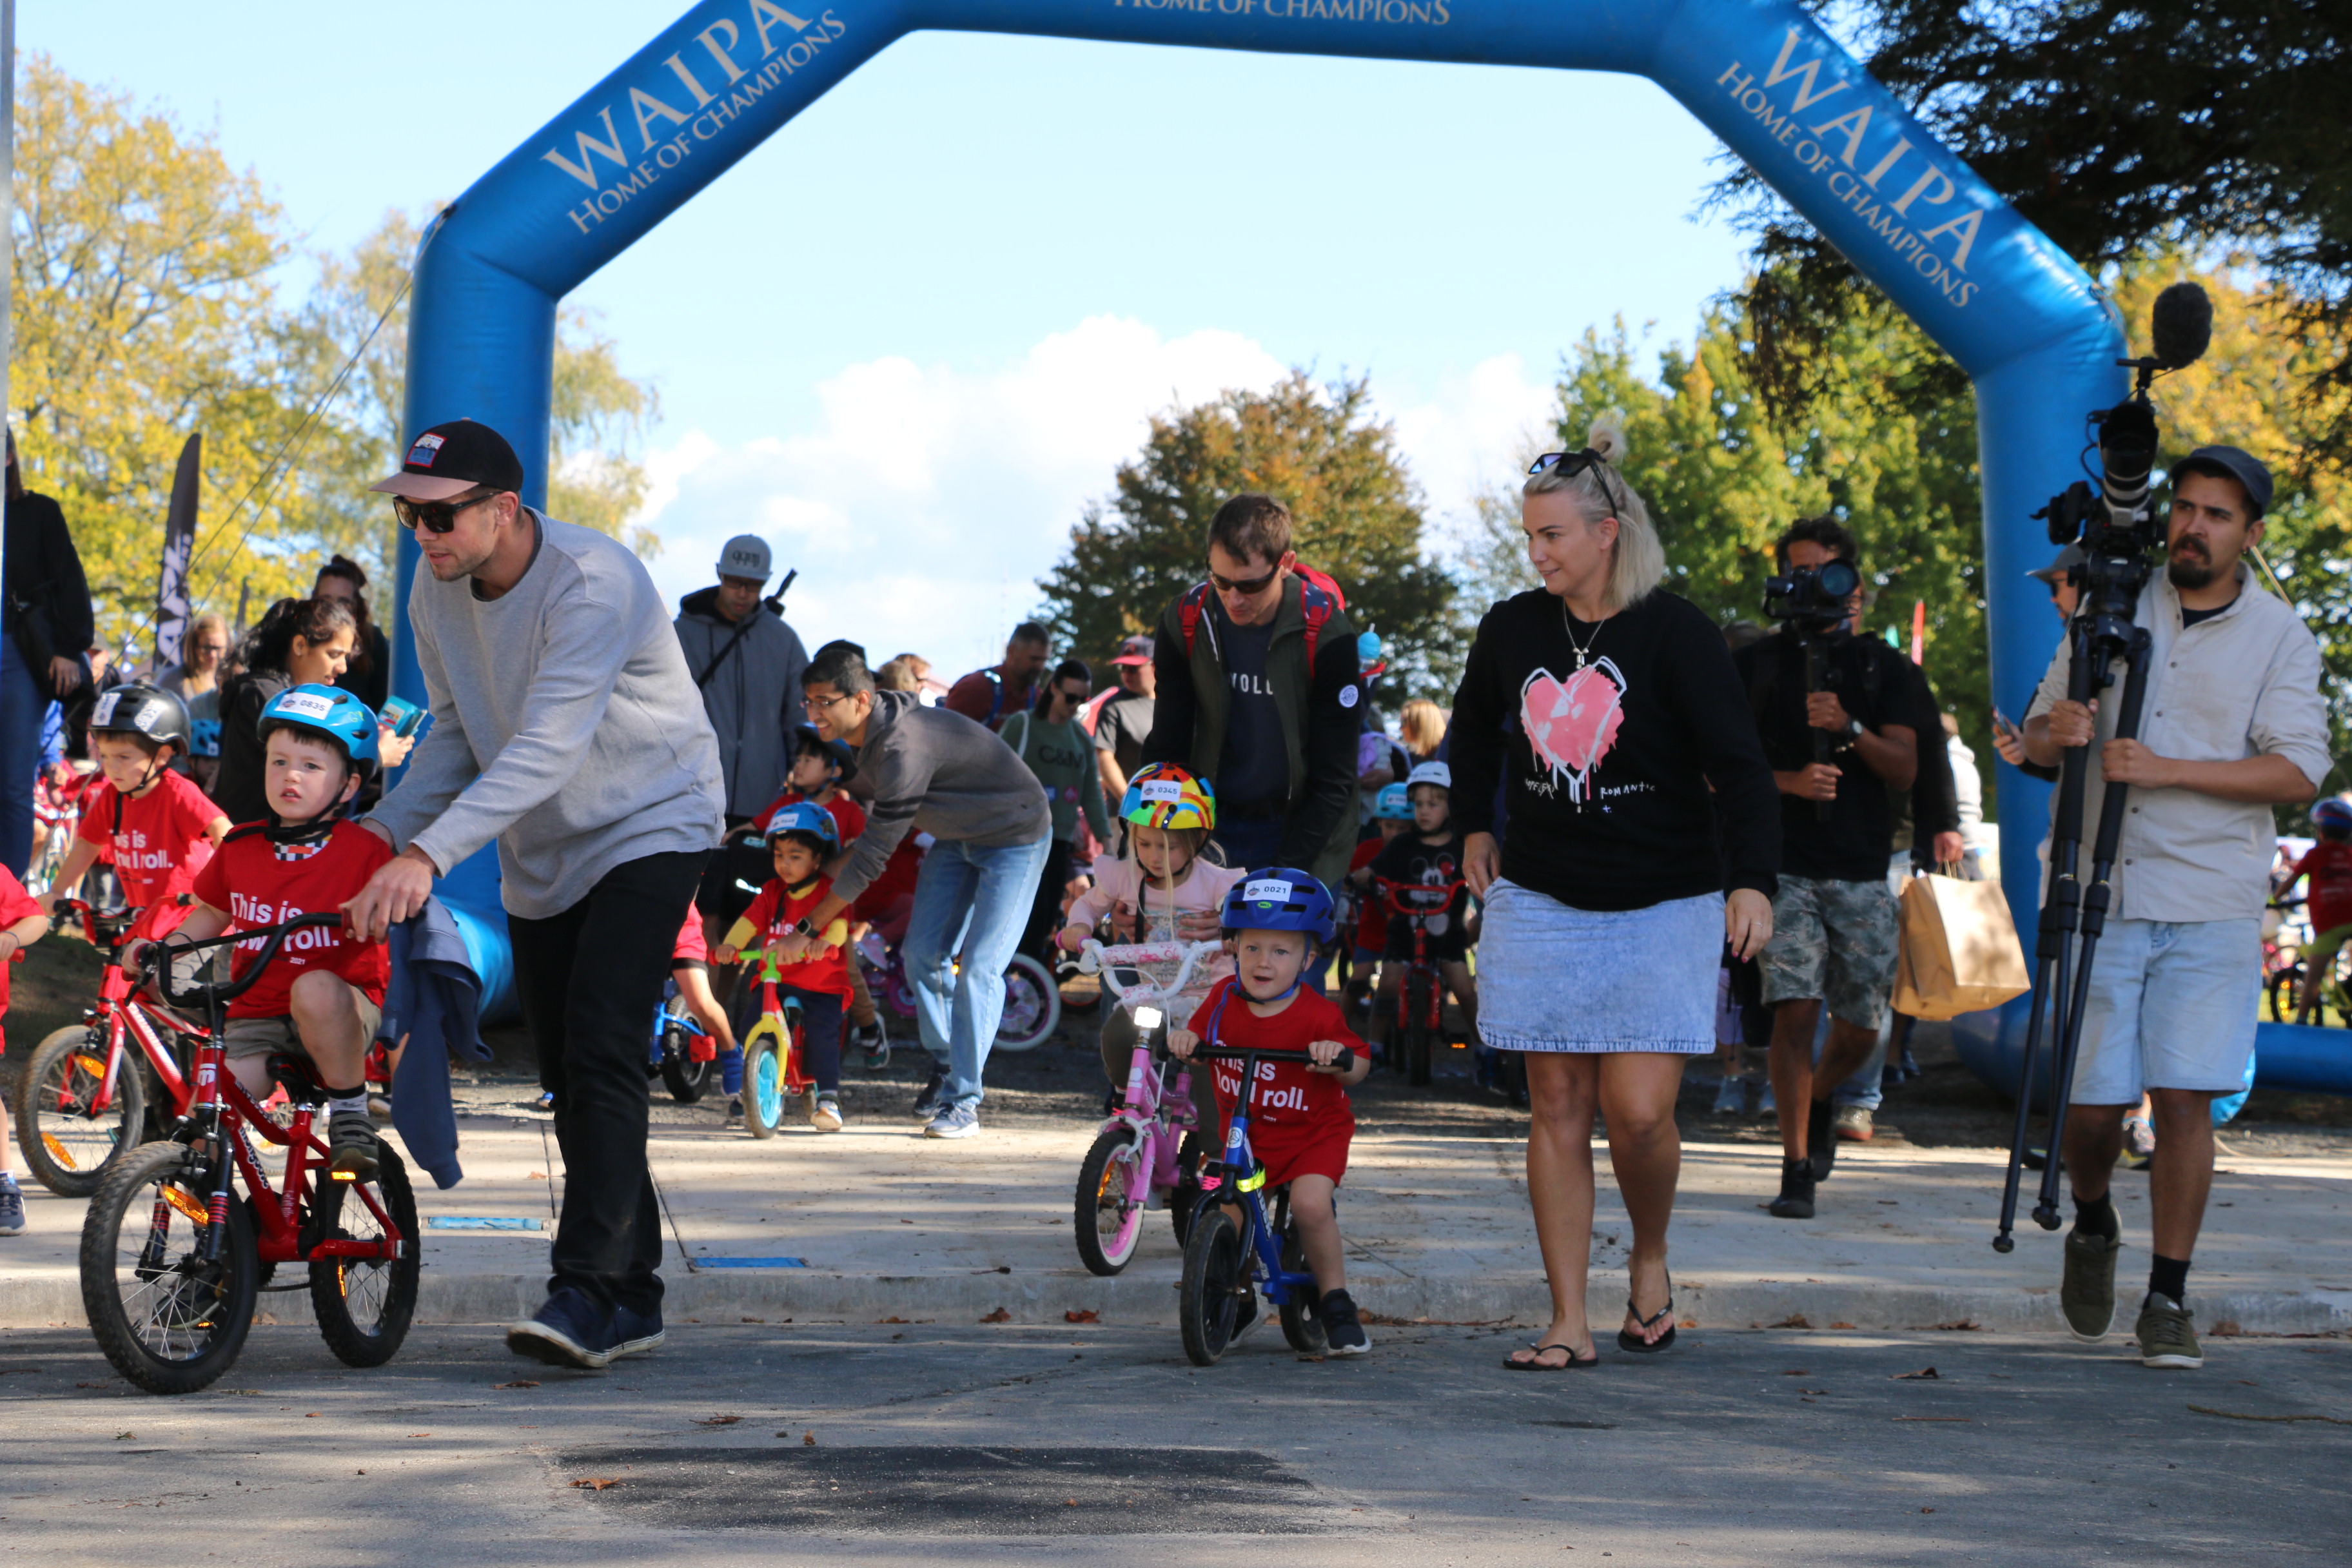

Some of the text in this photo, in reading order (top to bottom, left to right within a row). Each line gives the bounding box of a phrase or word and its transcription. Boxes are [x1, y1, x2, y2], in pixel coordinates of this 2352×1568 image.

[1218, 0, 1257, 14] OF
[1264, 0, 1451, 25] CHAMPIONS
[540, 0, 814, 191] WAIPA
[566, 8, 846, 235] HOME OF CHAMPIONS
[1763, 28, 1984, 274] WAIPA
[1716, 61, 1980, 308] HOME OF CHAMPIONS
[300, 700, 326, 711] 0835
[132, 830, 146, 848] is
[230, 892, 273, 923] This
[284, 925, 339, 952] roll.
[1262, 1086, 1309, 1112] roll.
